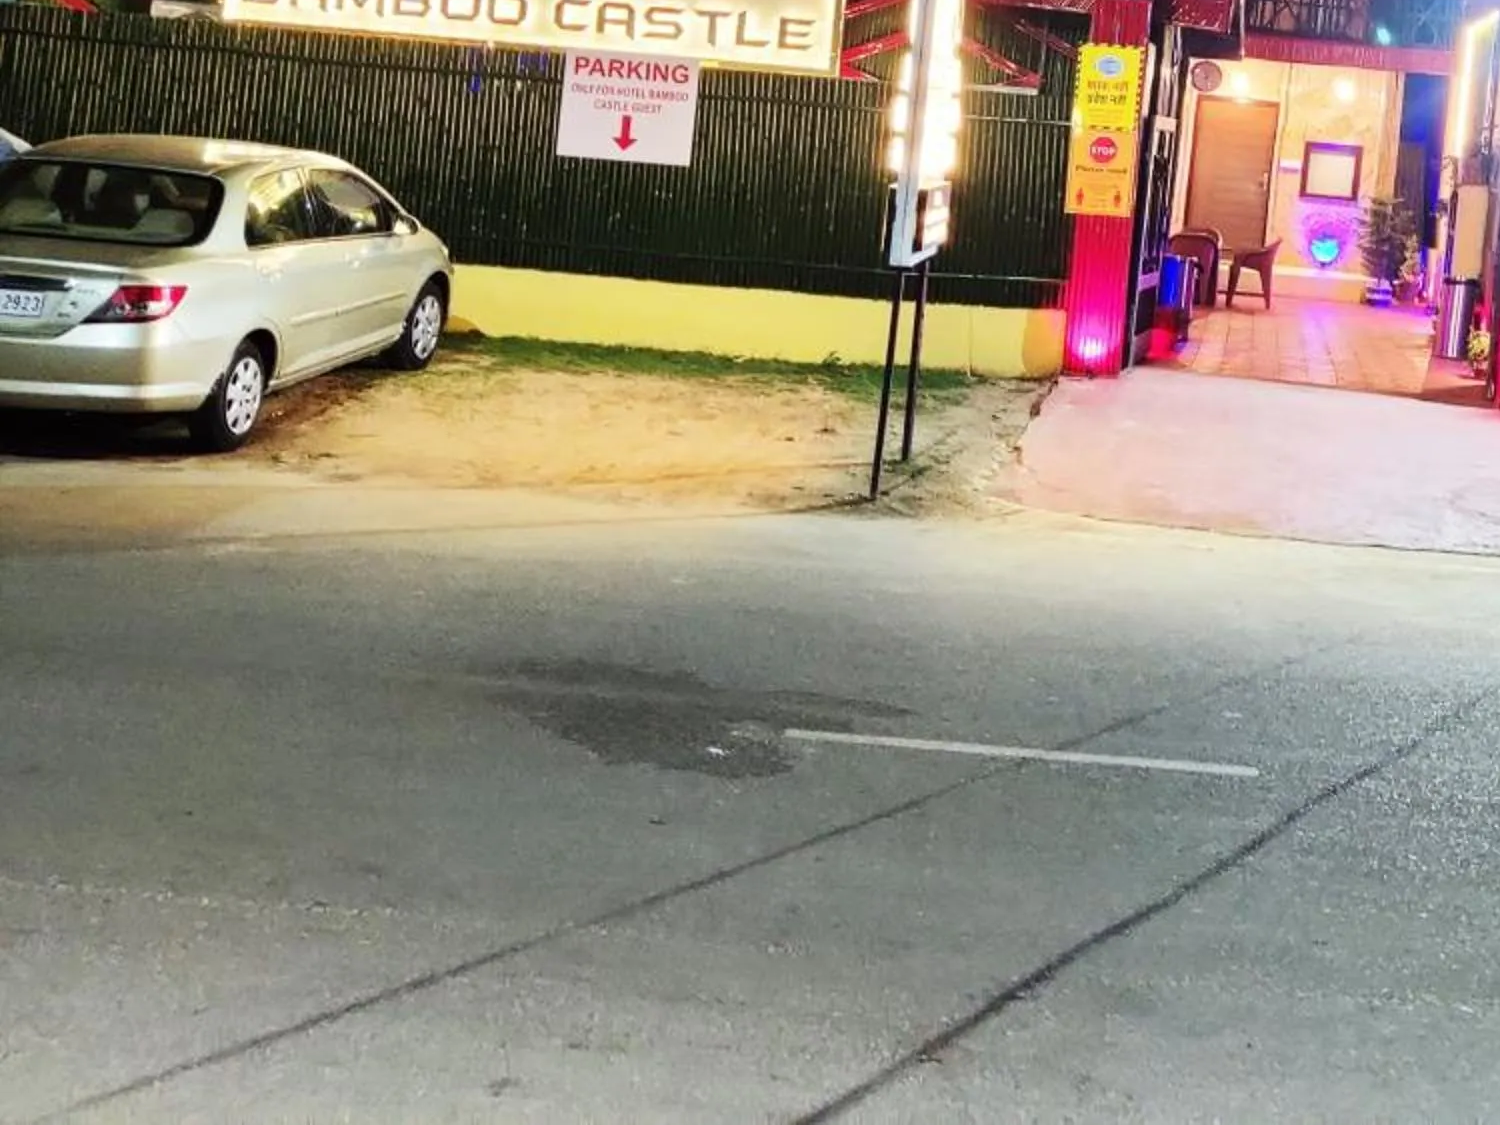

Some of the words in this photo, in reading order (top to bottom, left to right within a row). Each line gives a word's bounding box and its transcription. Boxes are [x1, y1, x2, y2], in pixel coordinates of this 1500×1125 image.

[574, 56, 690, 84] PARKING
[571, 82, 594, 93] ONLY
[595, 84, 615, 96] FOR
[616, 86, 646, 100] HOTEL
[649, 89, 689, 102] BAMBOO
[593, 98, 628, 112] CASTLE
[631, 102, 662, 114] GUEST
[1091, 146, 1116, 156] STOP
